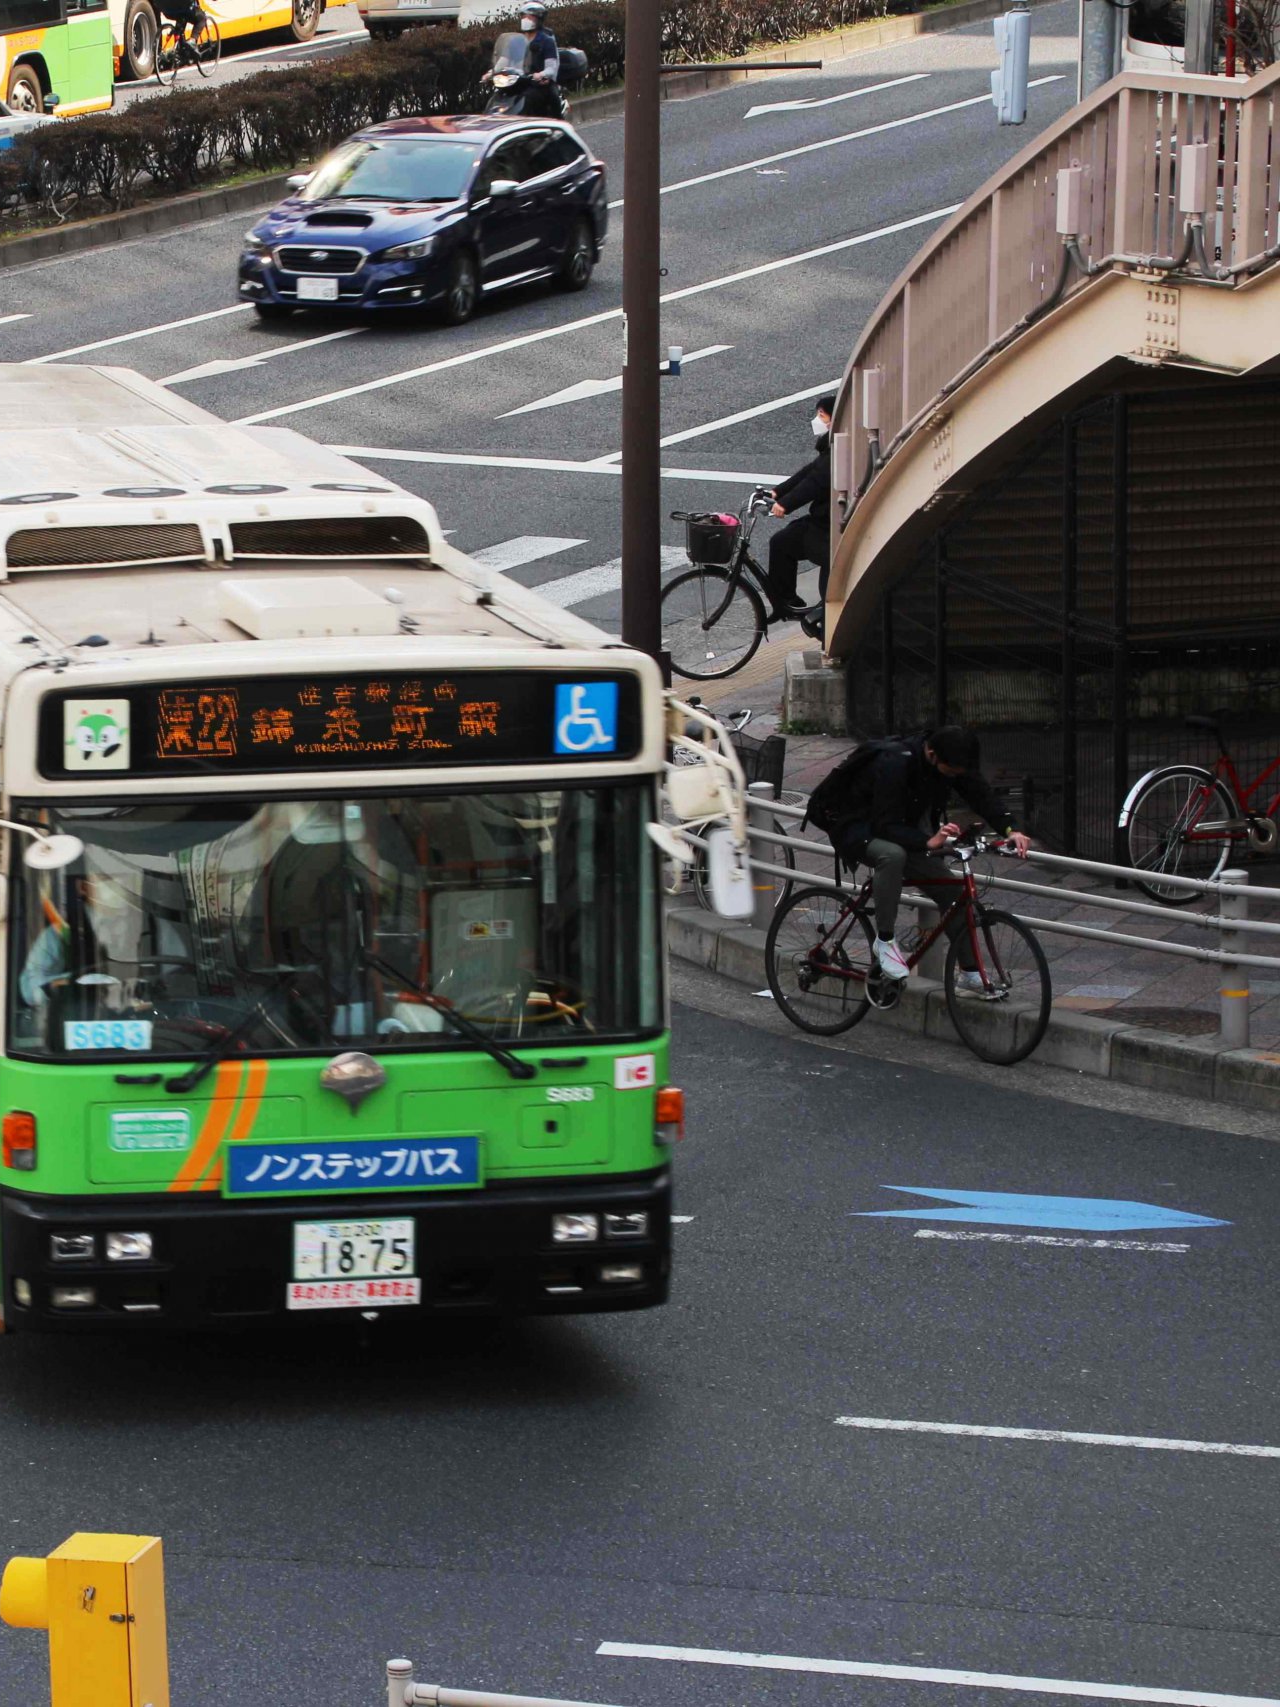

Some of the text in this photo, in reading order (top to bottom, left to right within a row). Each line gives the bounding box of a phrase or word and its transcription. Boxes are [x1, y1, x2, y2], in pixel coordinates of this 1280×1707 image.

[73, 1022, 145, 1049] S683
[546, 1086, 594, 1102] S683
[245, 1147, 464, 1182] ノンステップバス
[321, 1237, 409, 1274] 18-75
